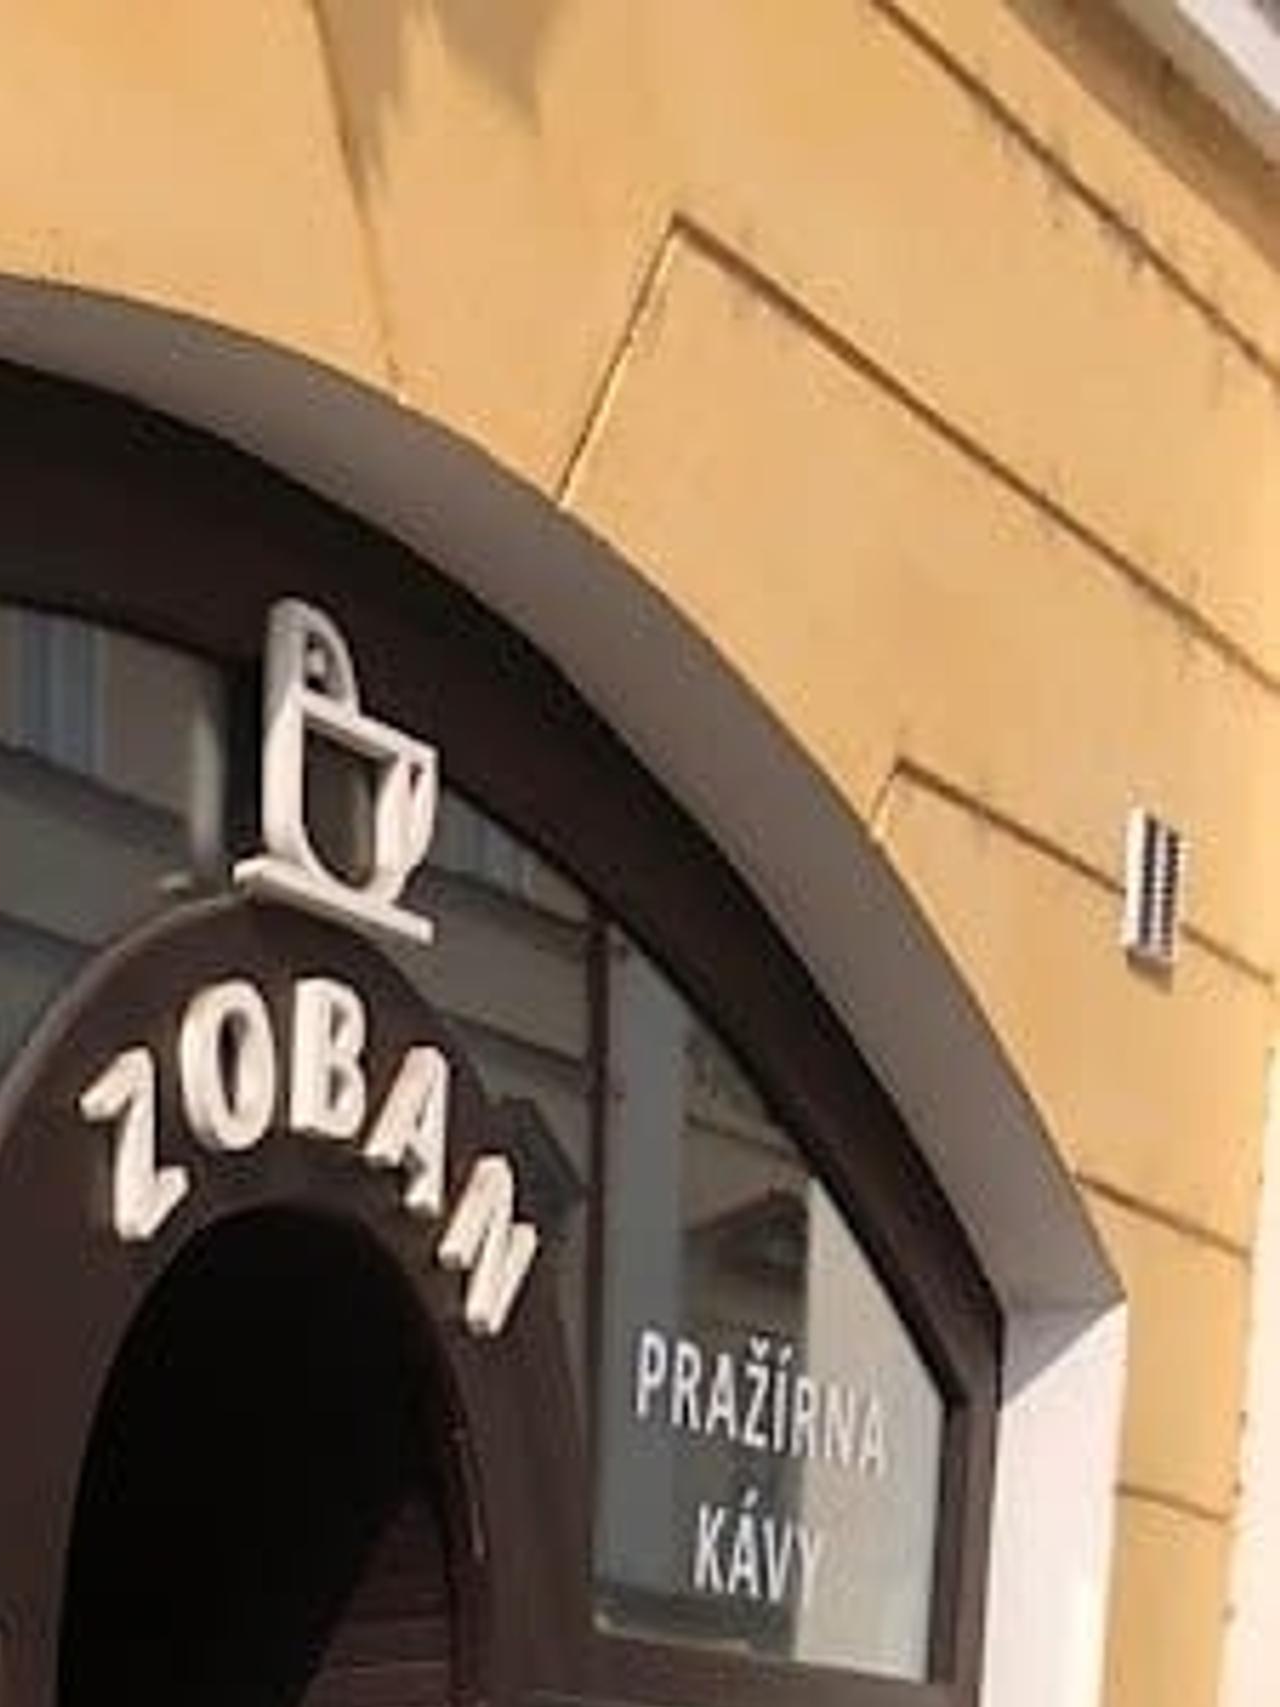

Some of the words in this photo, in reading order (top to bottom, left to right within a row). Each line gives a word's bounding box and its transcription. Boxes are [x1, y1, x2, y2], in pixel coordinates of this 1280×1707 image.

[80, 976, 538, 1336] ZOBAN
[636, 1328, 888, 1476] PRAŽÍRNA
[693, 1487, 822, 1606] KÁVY
